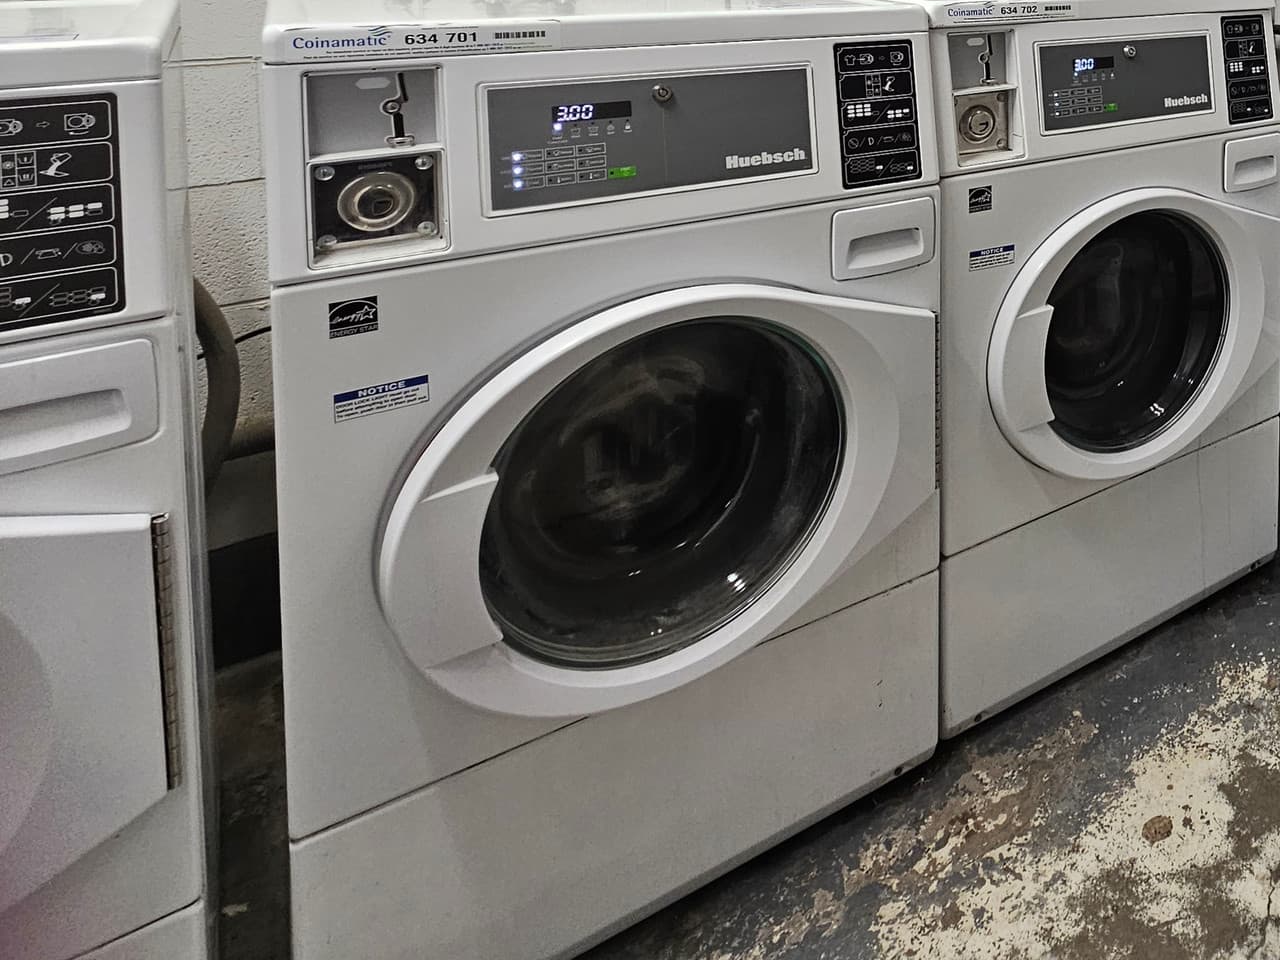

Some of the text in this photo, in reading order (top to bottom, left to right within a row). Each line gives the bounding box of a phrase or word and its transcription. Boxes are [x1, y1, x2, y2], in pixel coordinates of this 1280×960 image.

[947, 5, 1038, 17] Coinamatic 634 702
[292, 32, 477, 49] Coinamatic 634 701
[1074, 58, 1094, 71] 3.00
[1164, 93, 1208, 108] Huebsch
[557, 104, 593, 122] 3.00
[725, 148, 806, 169] Huebsch
[981, 247, 1004, 255] NOTICE
[358, 381, 406, 397] NOTICE
